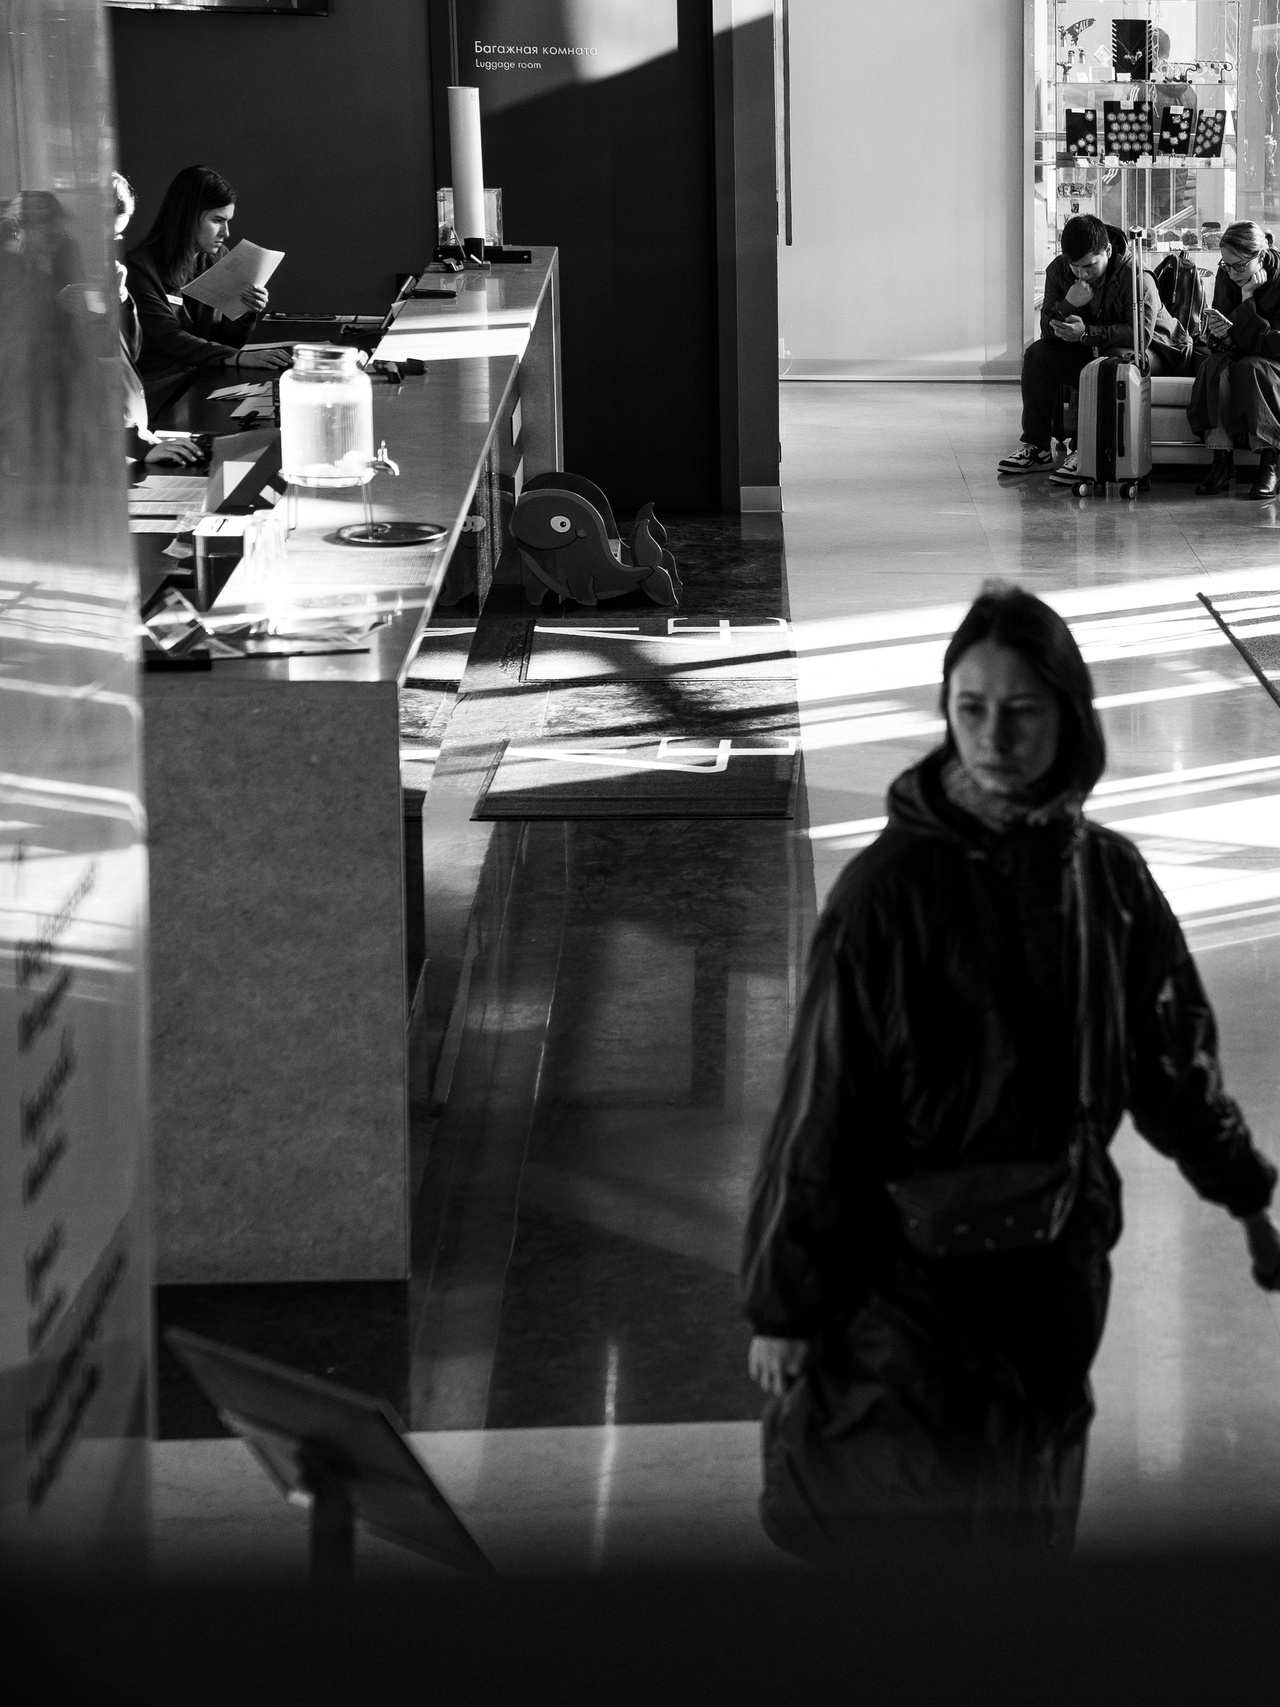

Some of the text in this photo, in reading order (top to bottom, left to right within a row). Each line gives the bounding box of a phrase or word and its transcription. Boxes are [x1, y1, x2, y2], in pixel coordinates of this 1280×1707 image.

[474, 41, 598, 56] Багажная комната
[475, 58, 542, 70] Luggage room
